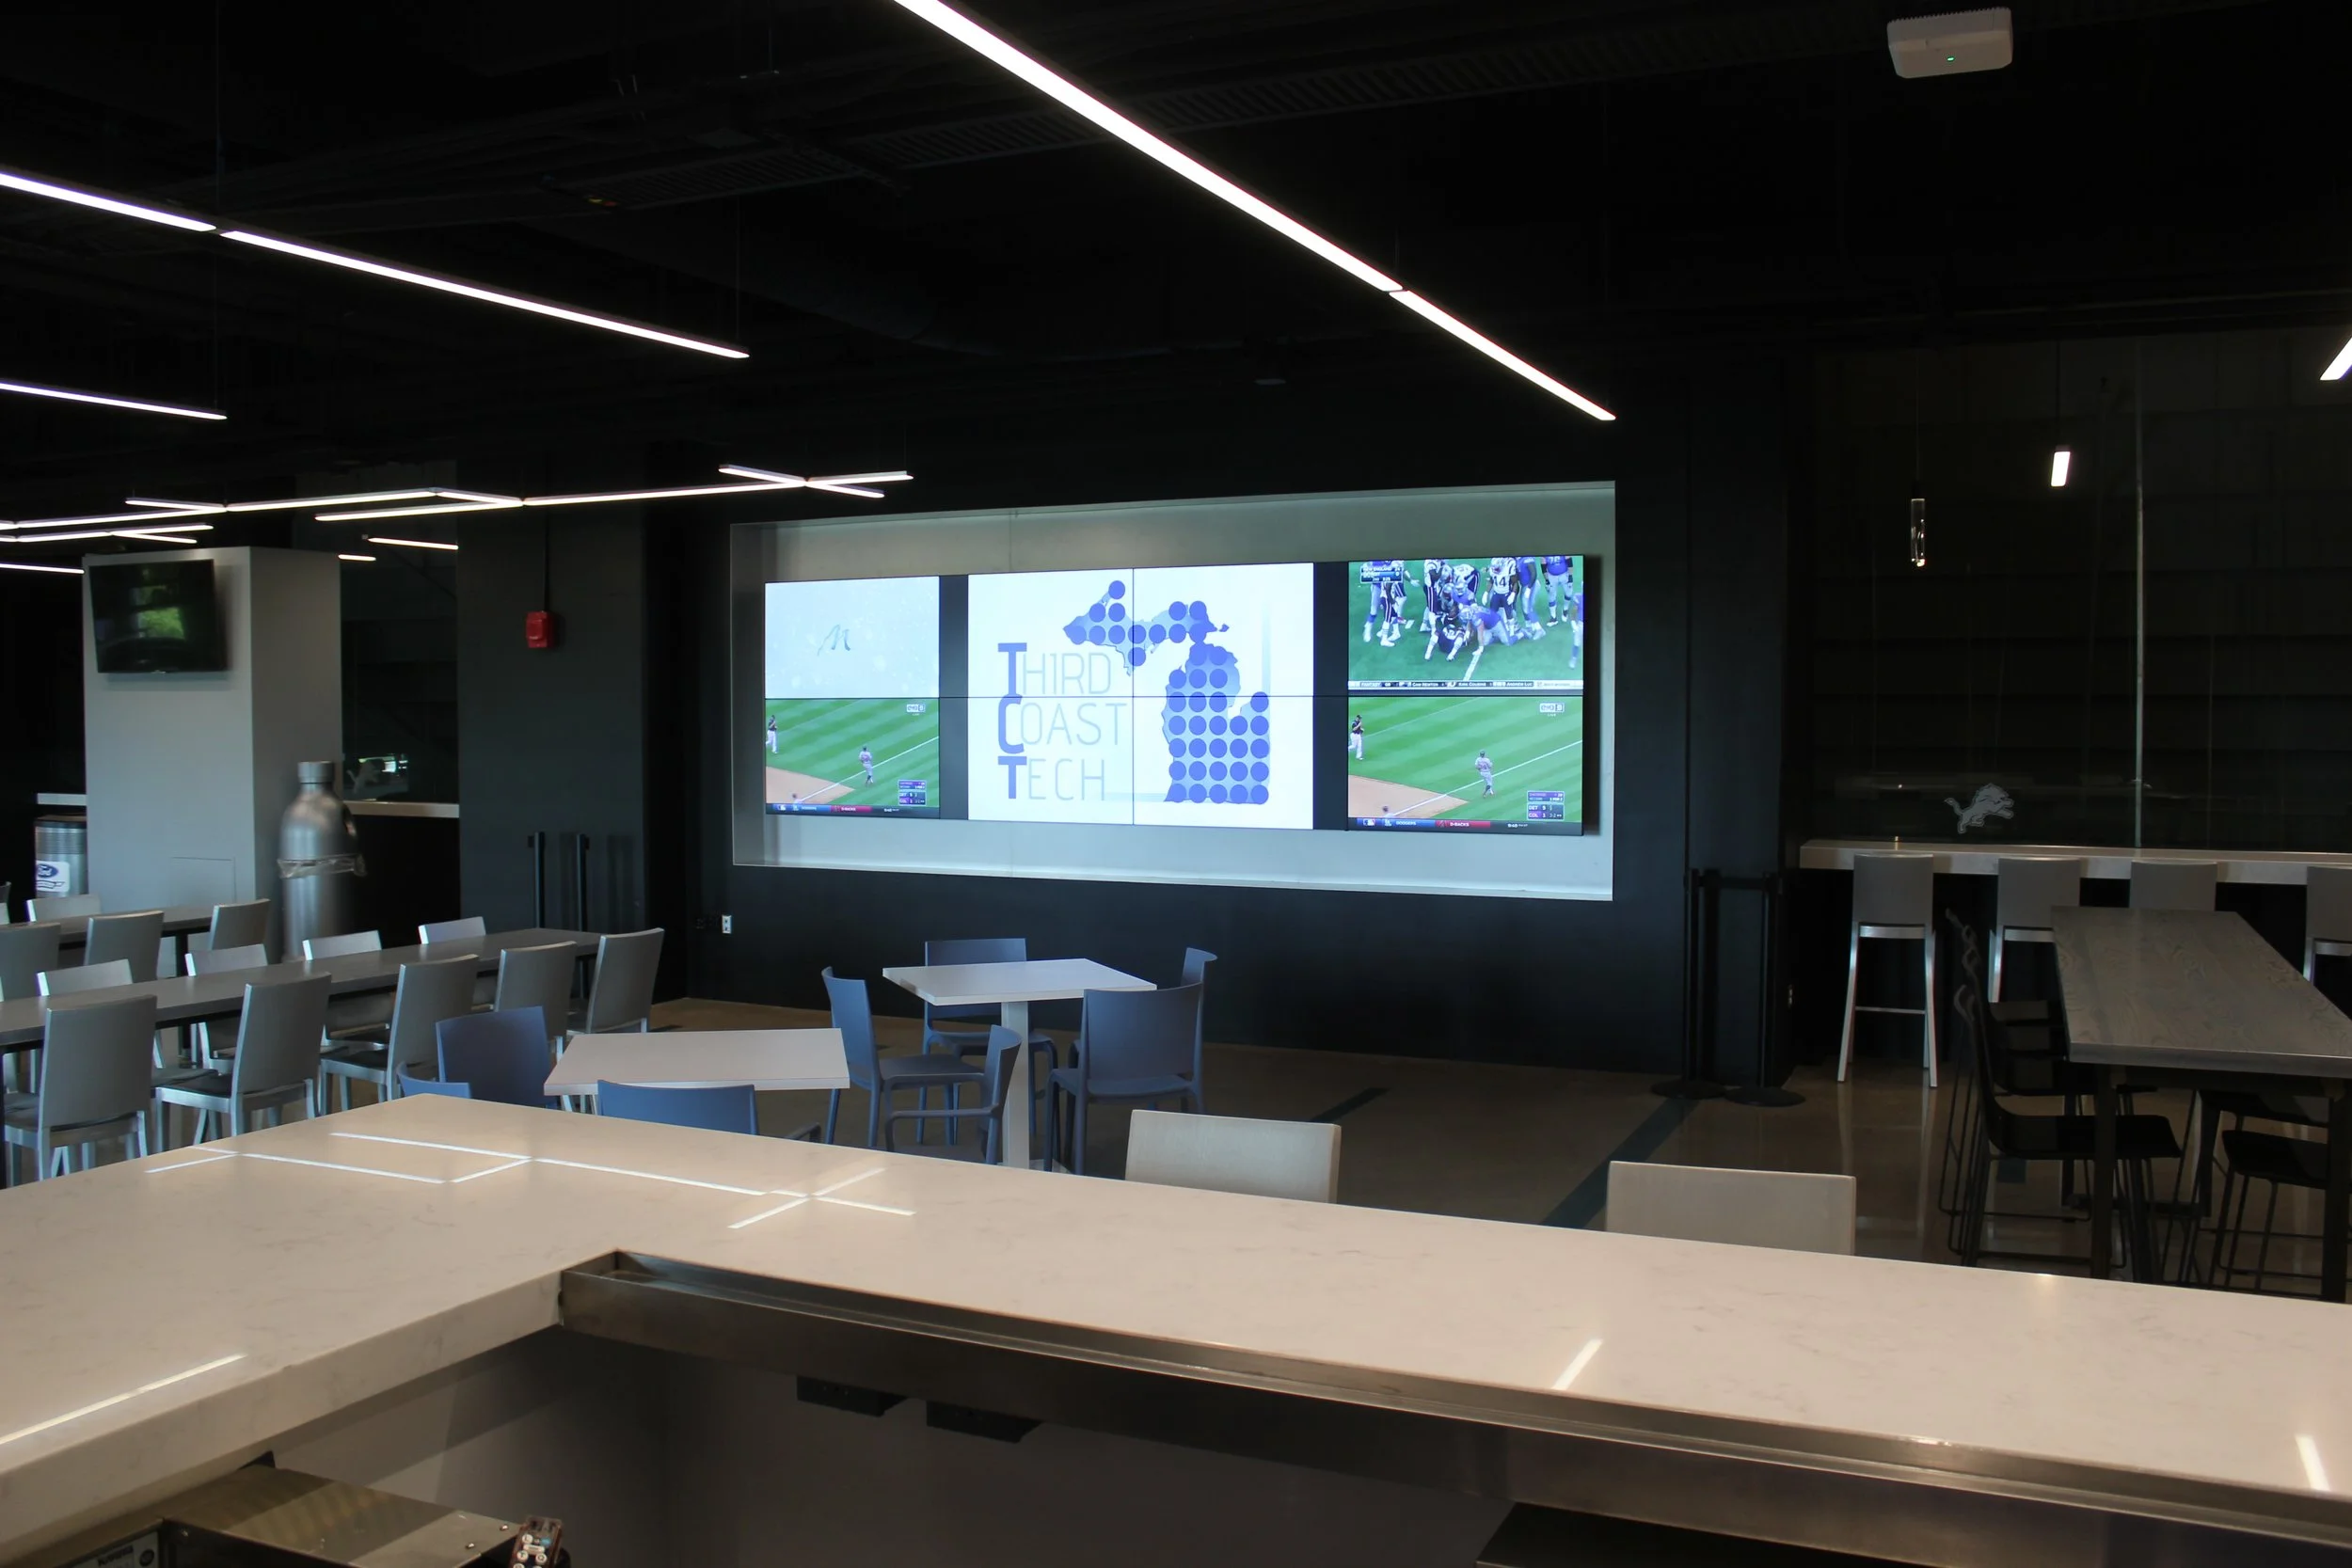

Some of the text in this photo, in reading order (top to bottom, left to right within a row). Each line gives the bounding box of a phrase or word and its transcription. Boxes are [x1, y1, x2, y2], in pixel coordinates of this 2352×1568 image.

[1493, 576, 1506, 587] 14
[997, 642, 1111, 696] THIRD
[997, 694, 1128, 754] COAST
[997, 755, 1105, 801] TECH
